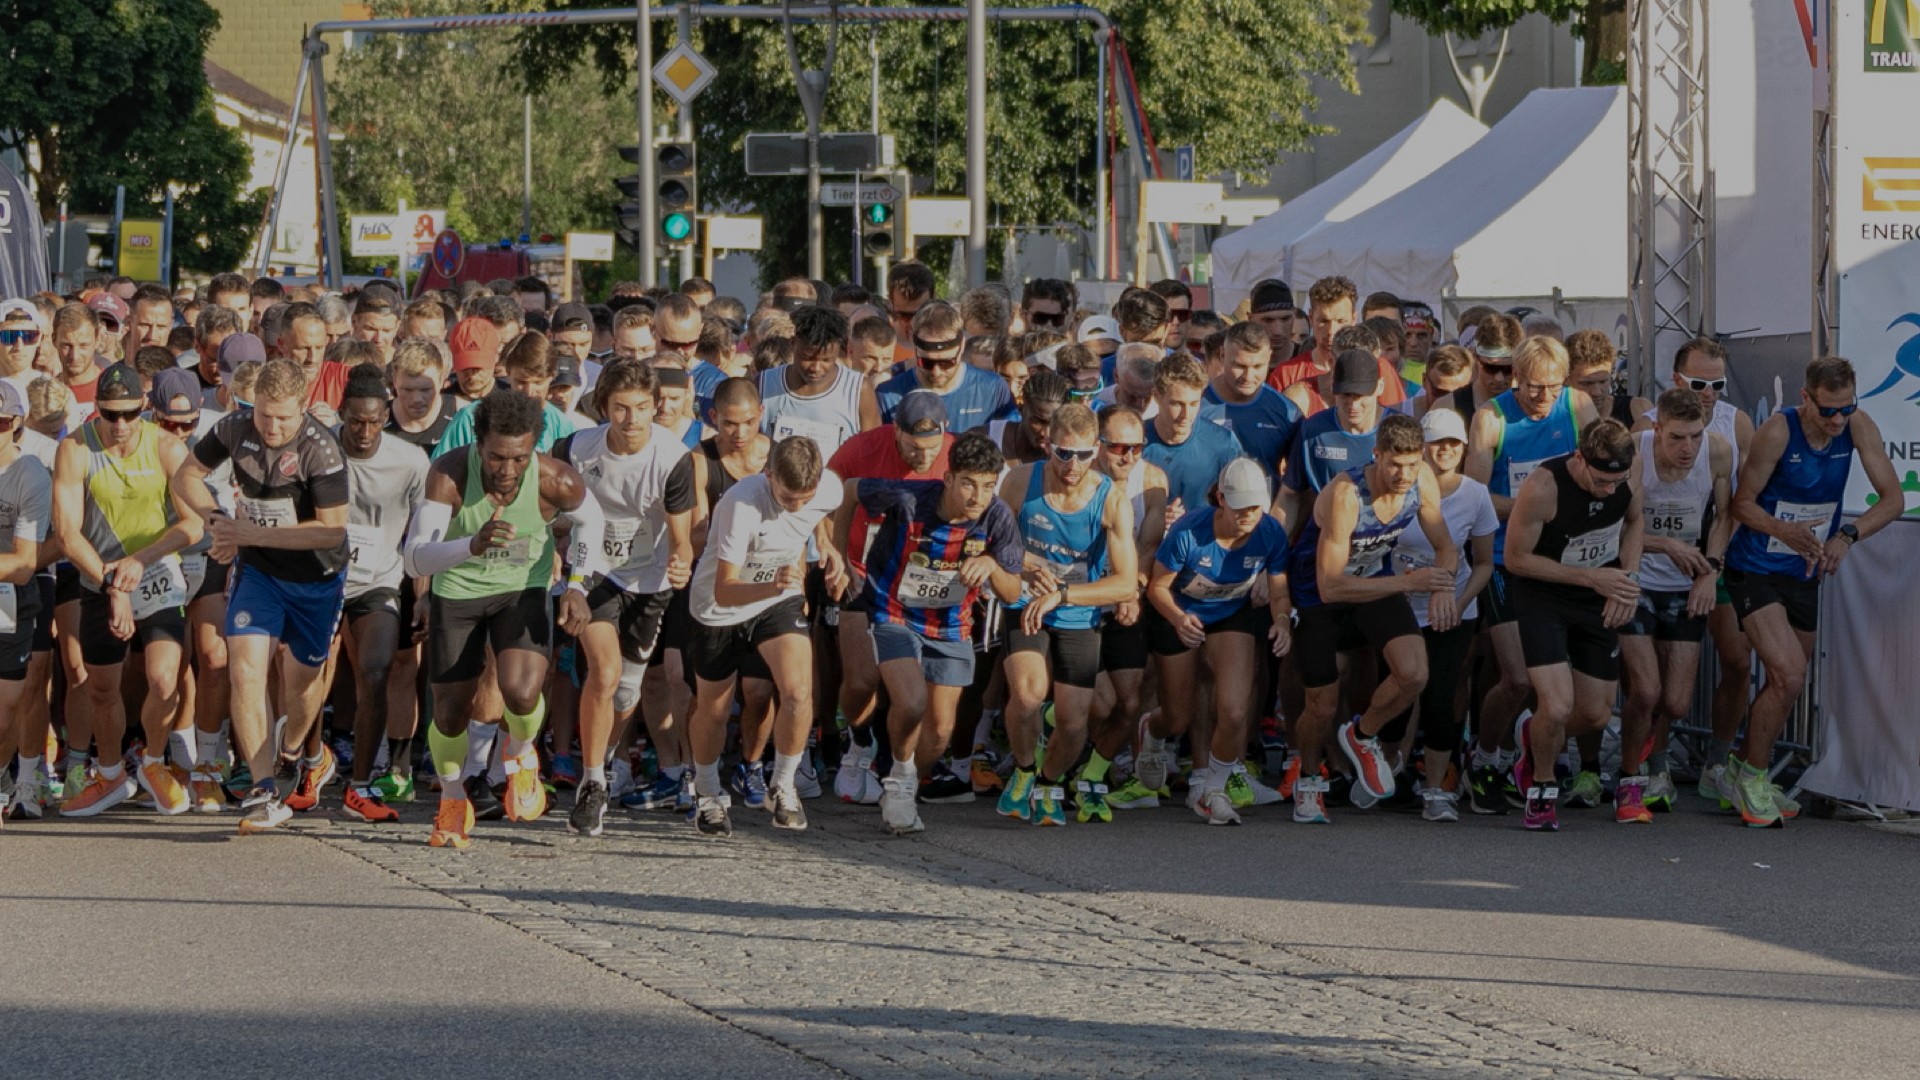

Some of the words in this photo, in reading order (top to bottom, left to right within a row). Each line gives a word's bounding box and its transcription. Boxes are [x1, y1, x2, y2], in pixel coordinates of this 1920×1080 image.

[831, 189, 877, 201] Tierrzt
[1882, 441, 1920, 460] NE
[1653, 516, 1683, 531] 845
[603, 540, 634, 557] 627
[139, 576, 173, 602] 342
[917, 583, 950, 599] 868
